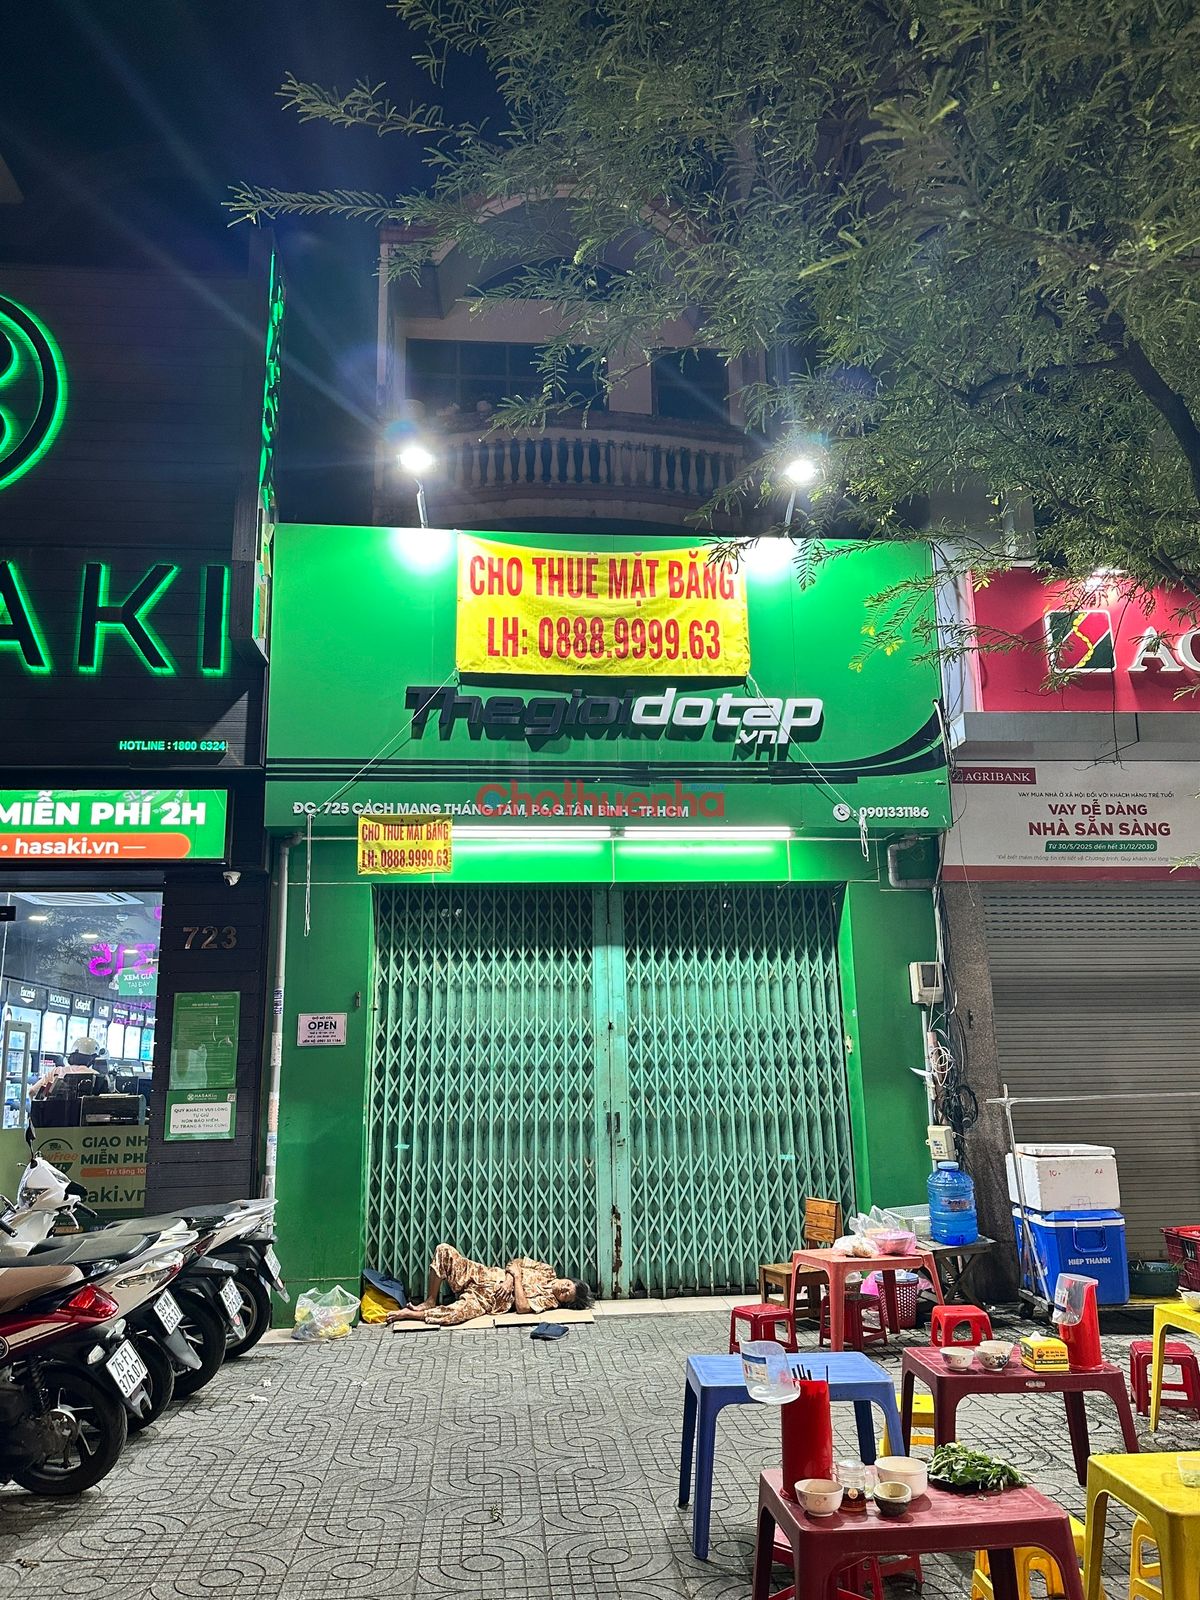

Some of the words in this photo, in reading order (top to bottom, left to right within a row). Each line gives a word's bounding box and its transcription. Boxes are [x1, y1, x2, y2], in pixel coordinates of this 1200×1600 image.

[470, 555, 522, 596] CHO
[609, 551, 660, 607] MẶT
[487, 616, 528, 657] LH:
[538, 616, 721, 660] 0888.9999.63
[200, 740, 226, 751] 6324
[965, 771, 1031, 783] AGRIBANK
[90, 795, 151, 826] PHÍ
[160, 801, 207, 826] 2H
[324, 802, 350, 814] 725
[352, 798, 393, 815] CÁCH
[444, 799, 493, 816] THÁNG
[1048, 804, 1077, 815] VAY
[1081, 799, 1102, 816] DỄ
[1105, 801, 1148, 816] DÀNG
[361, 823, 381, 841] CHO
[1028, 818, 1070, 836] NHÀ
[1075, 816, 1114, 837] SẴN
[1119, 818, 1171, 836] SÀNG
[15, 837, 120, 855] hasaki.vn
[1058, 843, 1093, 851] 30/5/2025
[1120, 843, 1155, 851] 31/12/2030
[361, 849, 378, 868] LH:
[381, 848, 449, 868] 0888.9999.63
[182, 925, 238, 950] 723
[308, 1020, 338, 1030] OPEN
[82, 1135, 122, 1148] GIAO
[80, 1148, 119, 1165] MIỄN
[119, 1358, 144, 1394] 376.07
